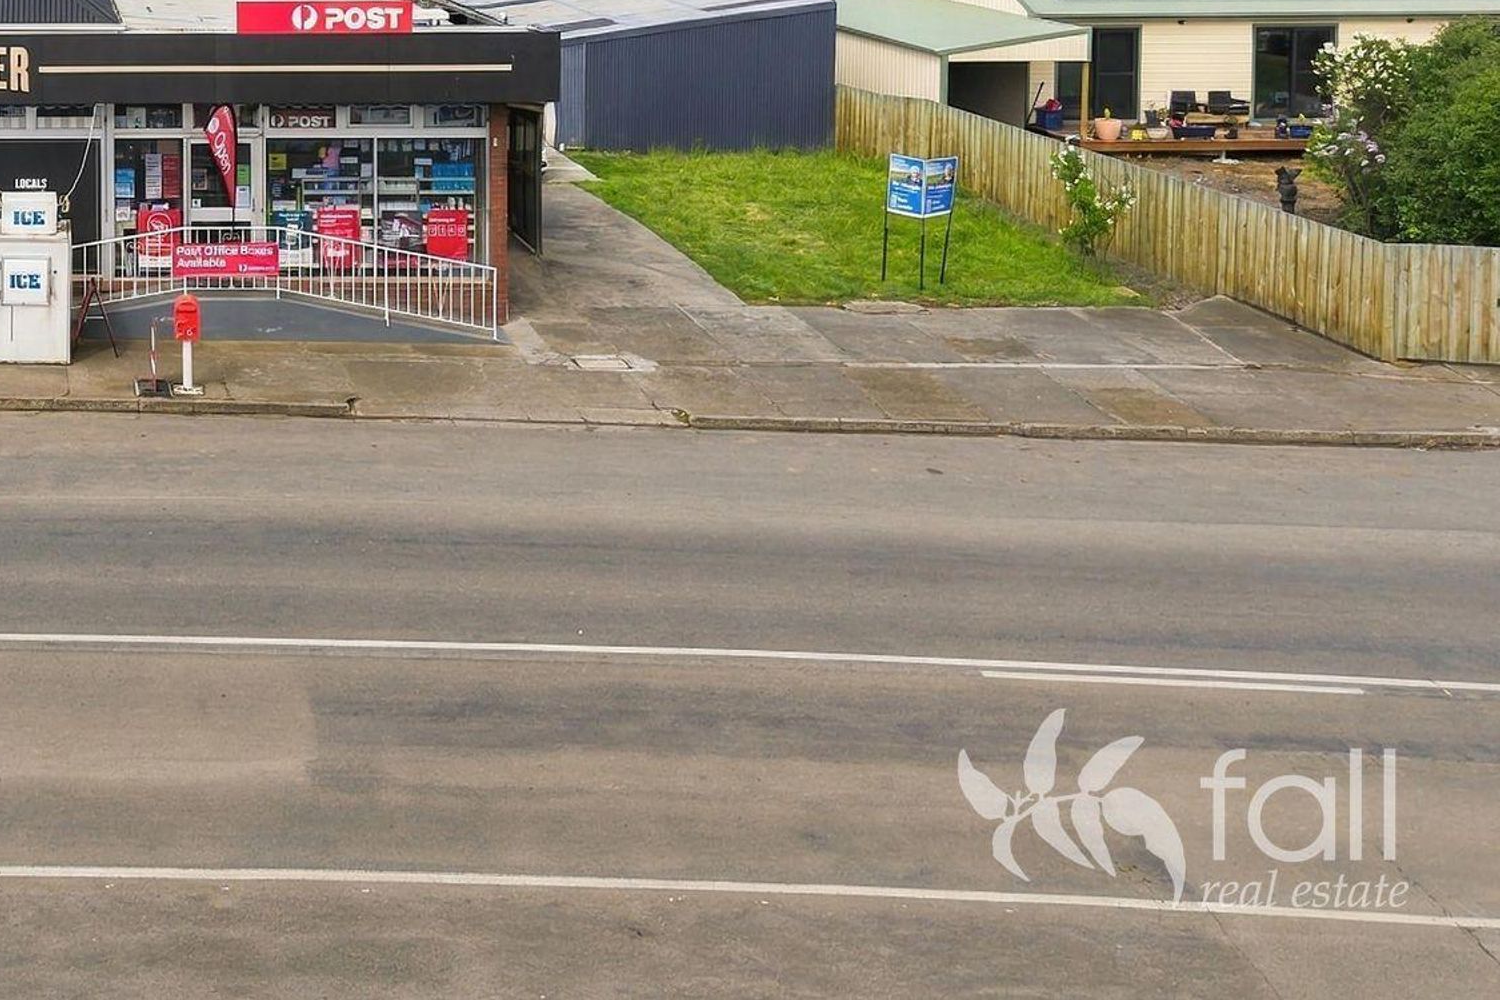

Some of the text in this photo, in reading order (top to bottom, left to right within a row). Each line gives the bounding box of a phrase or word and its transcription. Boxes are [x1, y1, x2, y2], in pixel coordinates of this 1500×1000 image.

[324, 7, 404, 30] POST
[287, 115, 332, 128] POST
[213, 131, 233, 176] Open
[14, 178, 48, 189] LOCALS
[13, 210, 46, 226] ICE
[175, 245, 274, 257] Post Office Boxes
[175, 258, 227, 269] Available
[9, 274, 41, 290] ICE
